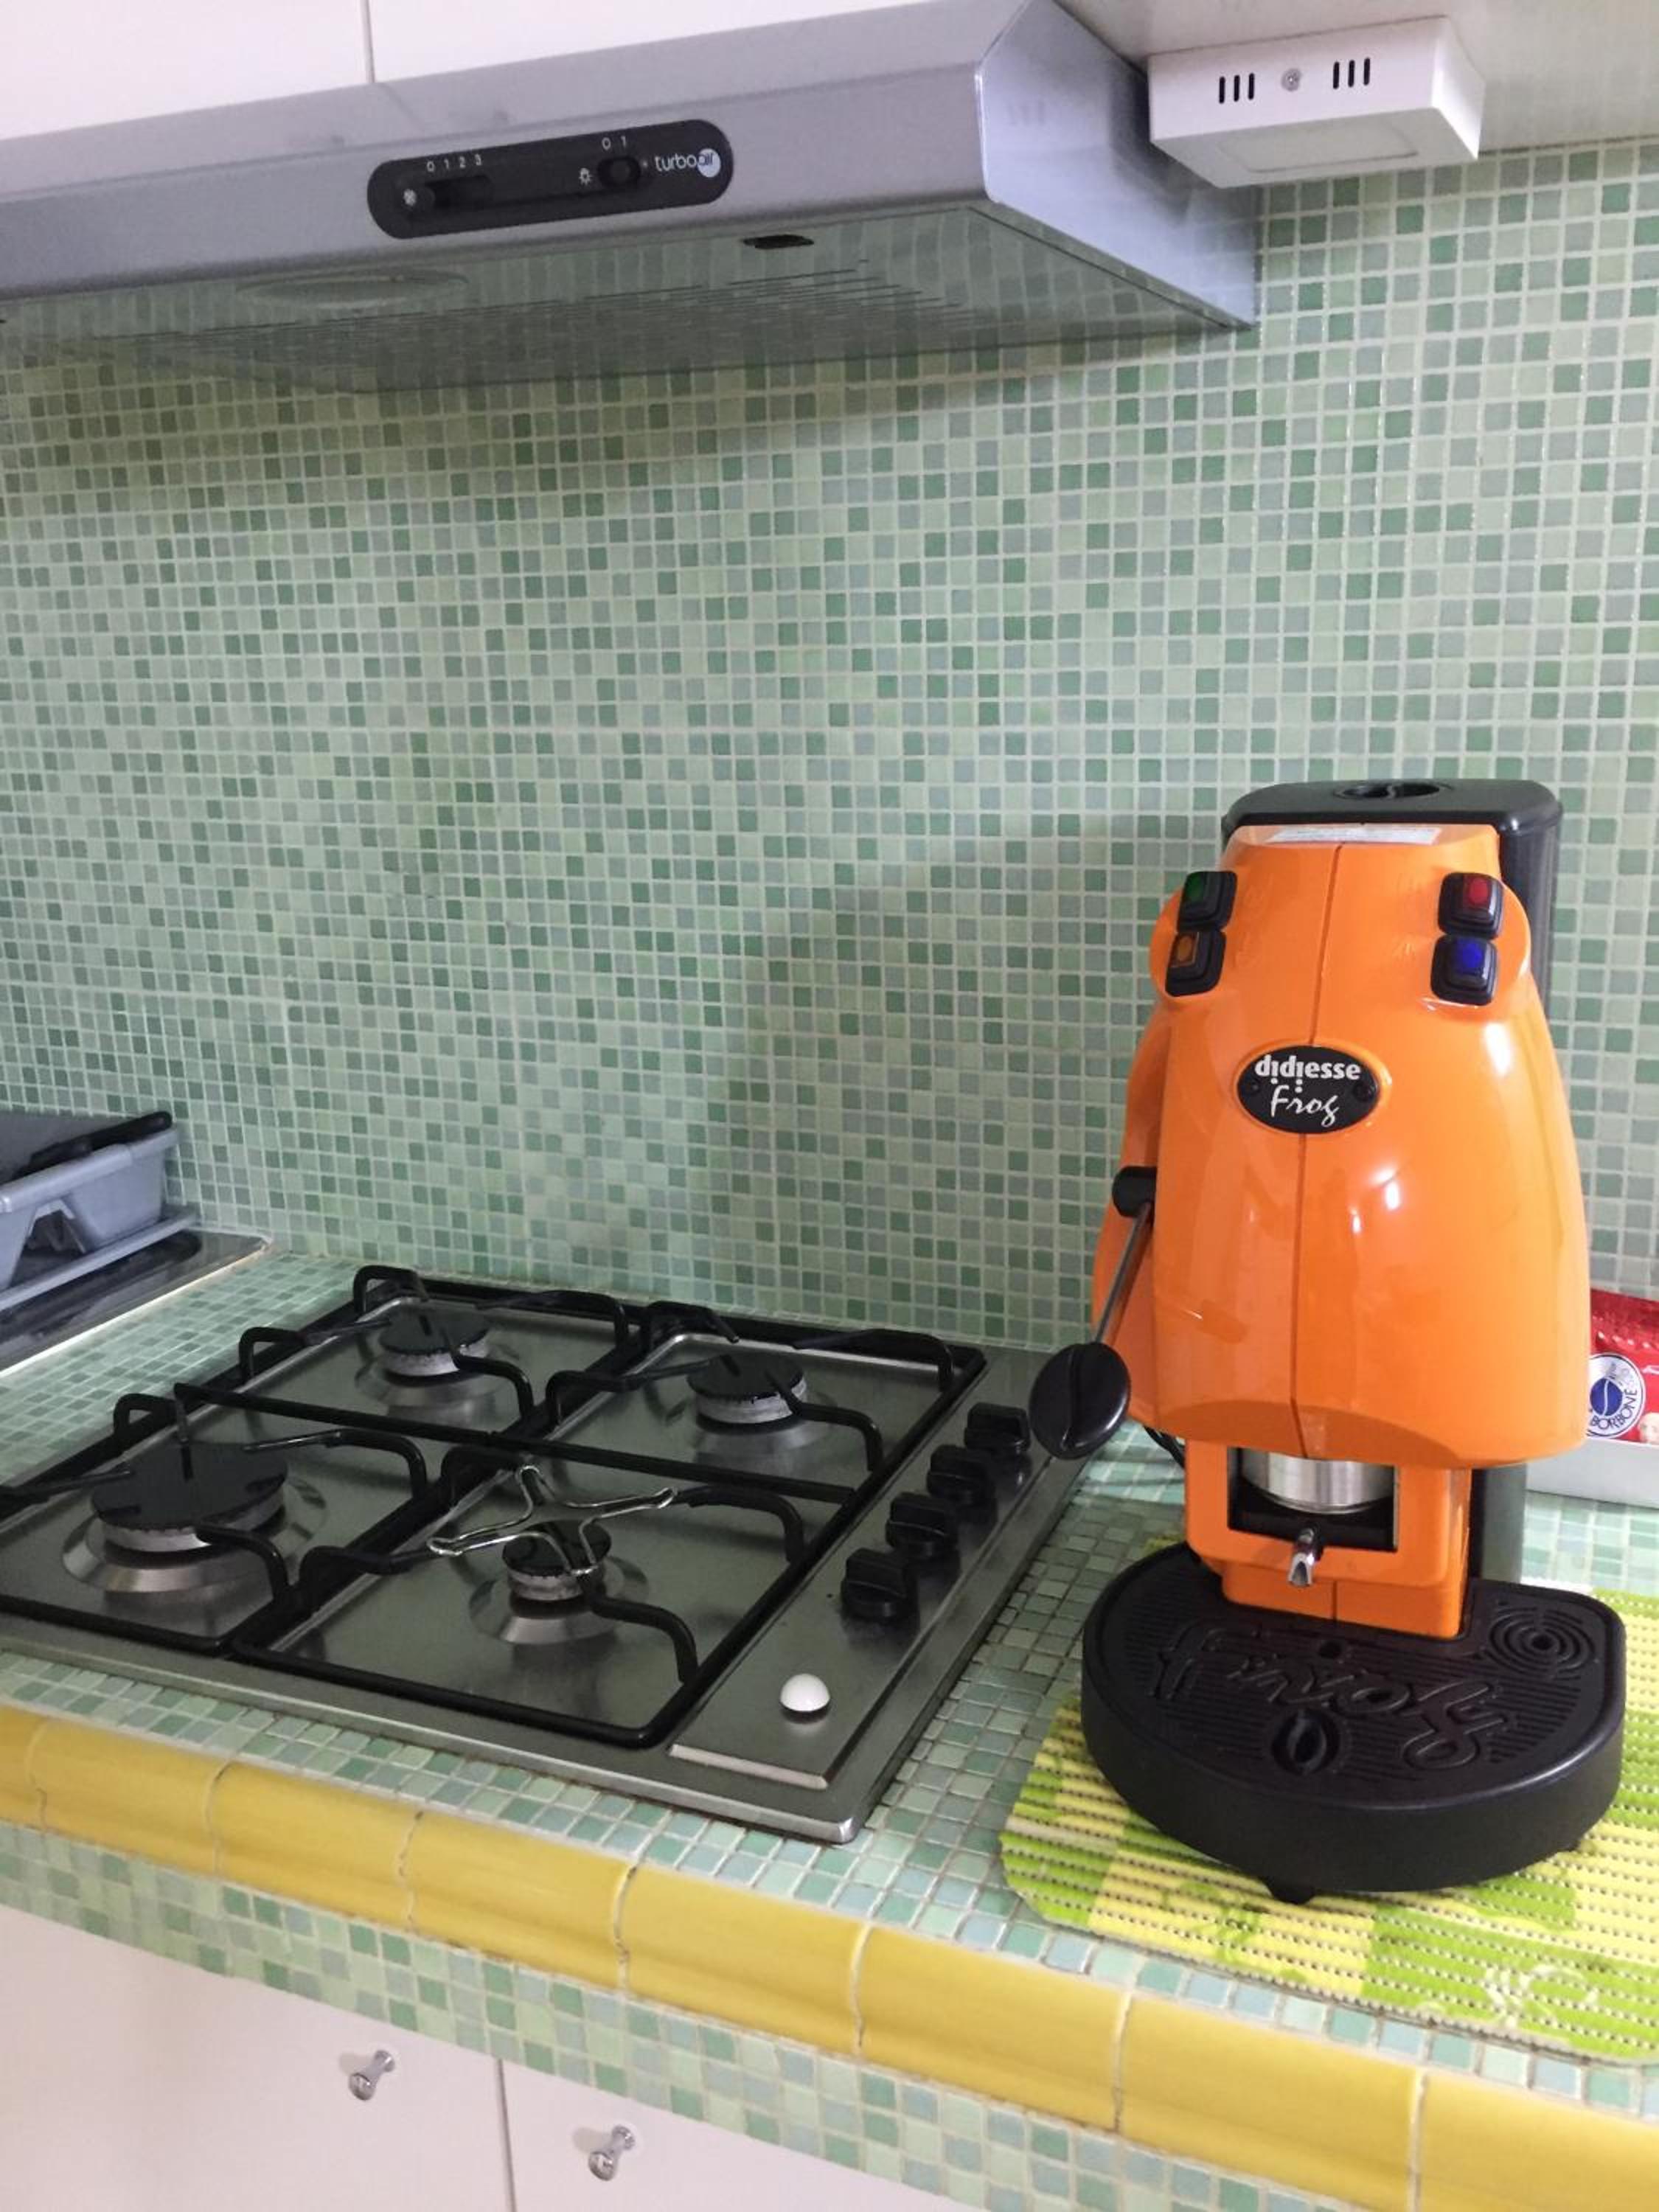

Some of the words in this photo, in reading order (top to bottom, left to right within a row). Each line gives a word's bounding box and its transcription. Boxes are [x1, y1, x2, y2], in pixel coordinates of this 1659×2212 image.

[602, 137, 611, 150] 0
[622, 135, 627, 147] 1
[426, 160, 435, 173] 0
[443, 159, 449, 170] 1
[459, 156, 467, 168] 2
[475, 153, 483, 166] 3
[1254, 1054, 1361, 1085] didiesse
[1270, 1085, 1340, 1127] Frog
[1589, 1388, 1638, 1430] BORBONE
